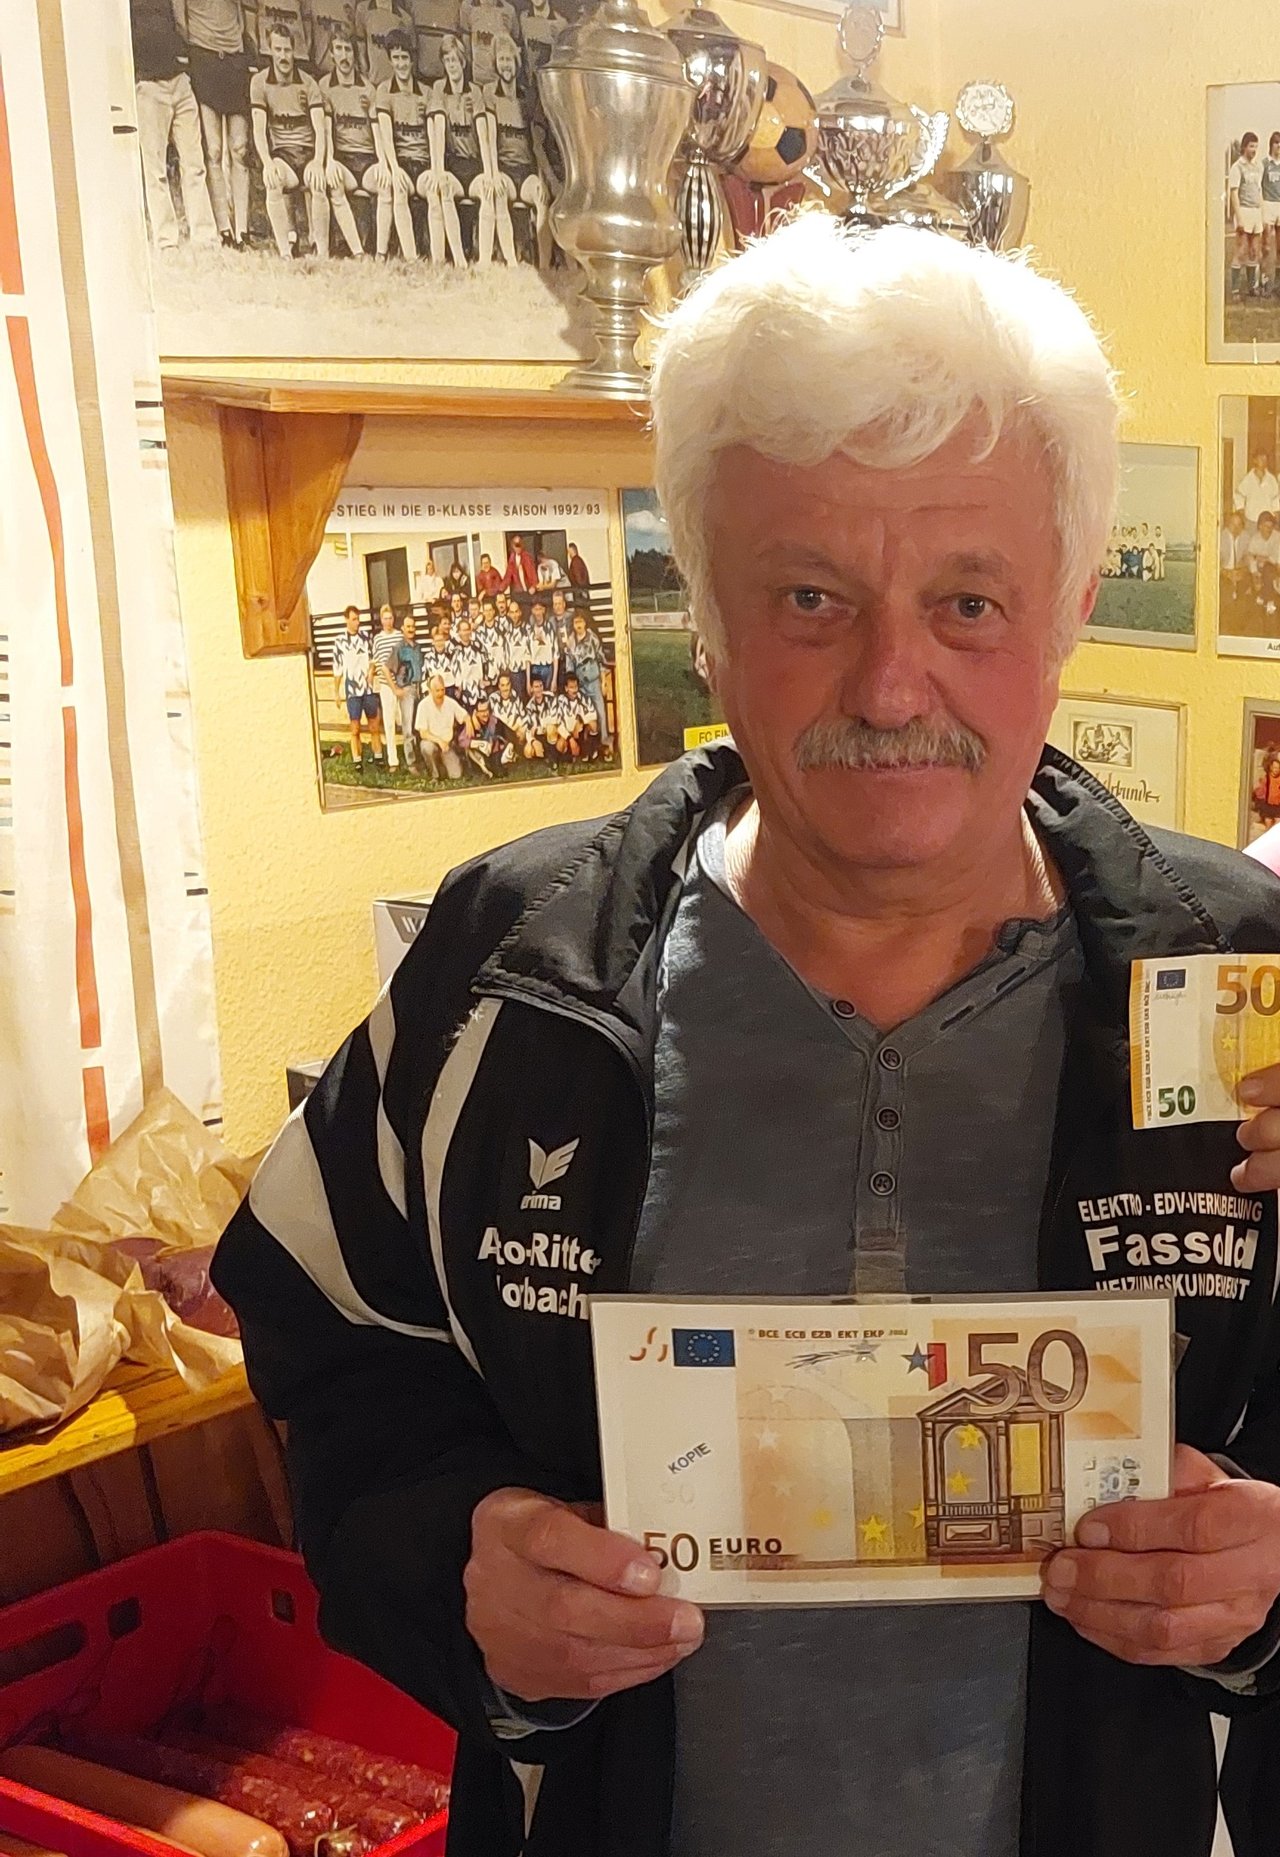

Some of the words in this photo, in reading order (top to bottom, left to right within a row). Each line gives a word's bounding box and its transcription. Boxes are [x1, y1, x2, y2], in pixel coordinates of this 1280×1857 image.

[331, 504, 377, 517] STIEG
[383, 504, 395, 516] IN
[402, 504, 421, 516] DIE
[428, 504, 492, 516] B-KLASSE
[503, 504, 547, 516] SAISON
[553, 503, 601, 516] 1992/93
[698, 731, 712, 743] FC
[1158, 1085, 1196, 1119] 50
[1085, 1224, 1259, 1272] Fassold
[758, 1329, 779, 1338] BCE
[785, 1329, 806, 1338] ECB
[811, 1330, 831, 1338] EZB
[838, 1330, 858, 1338] EKT
[863, 1330, 884, 1338] EKP
[968, 1329, 1088, 1415] 50
[667, 1442, 712, 1475] KOPIE
[643, 1531, 700, 1572] 50
[709, 1538, 783, 1555] EURO
